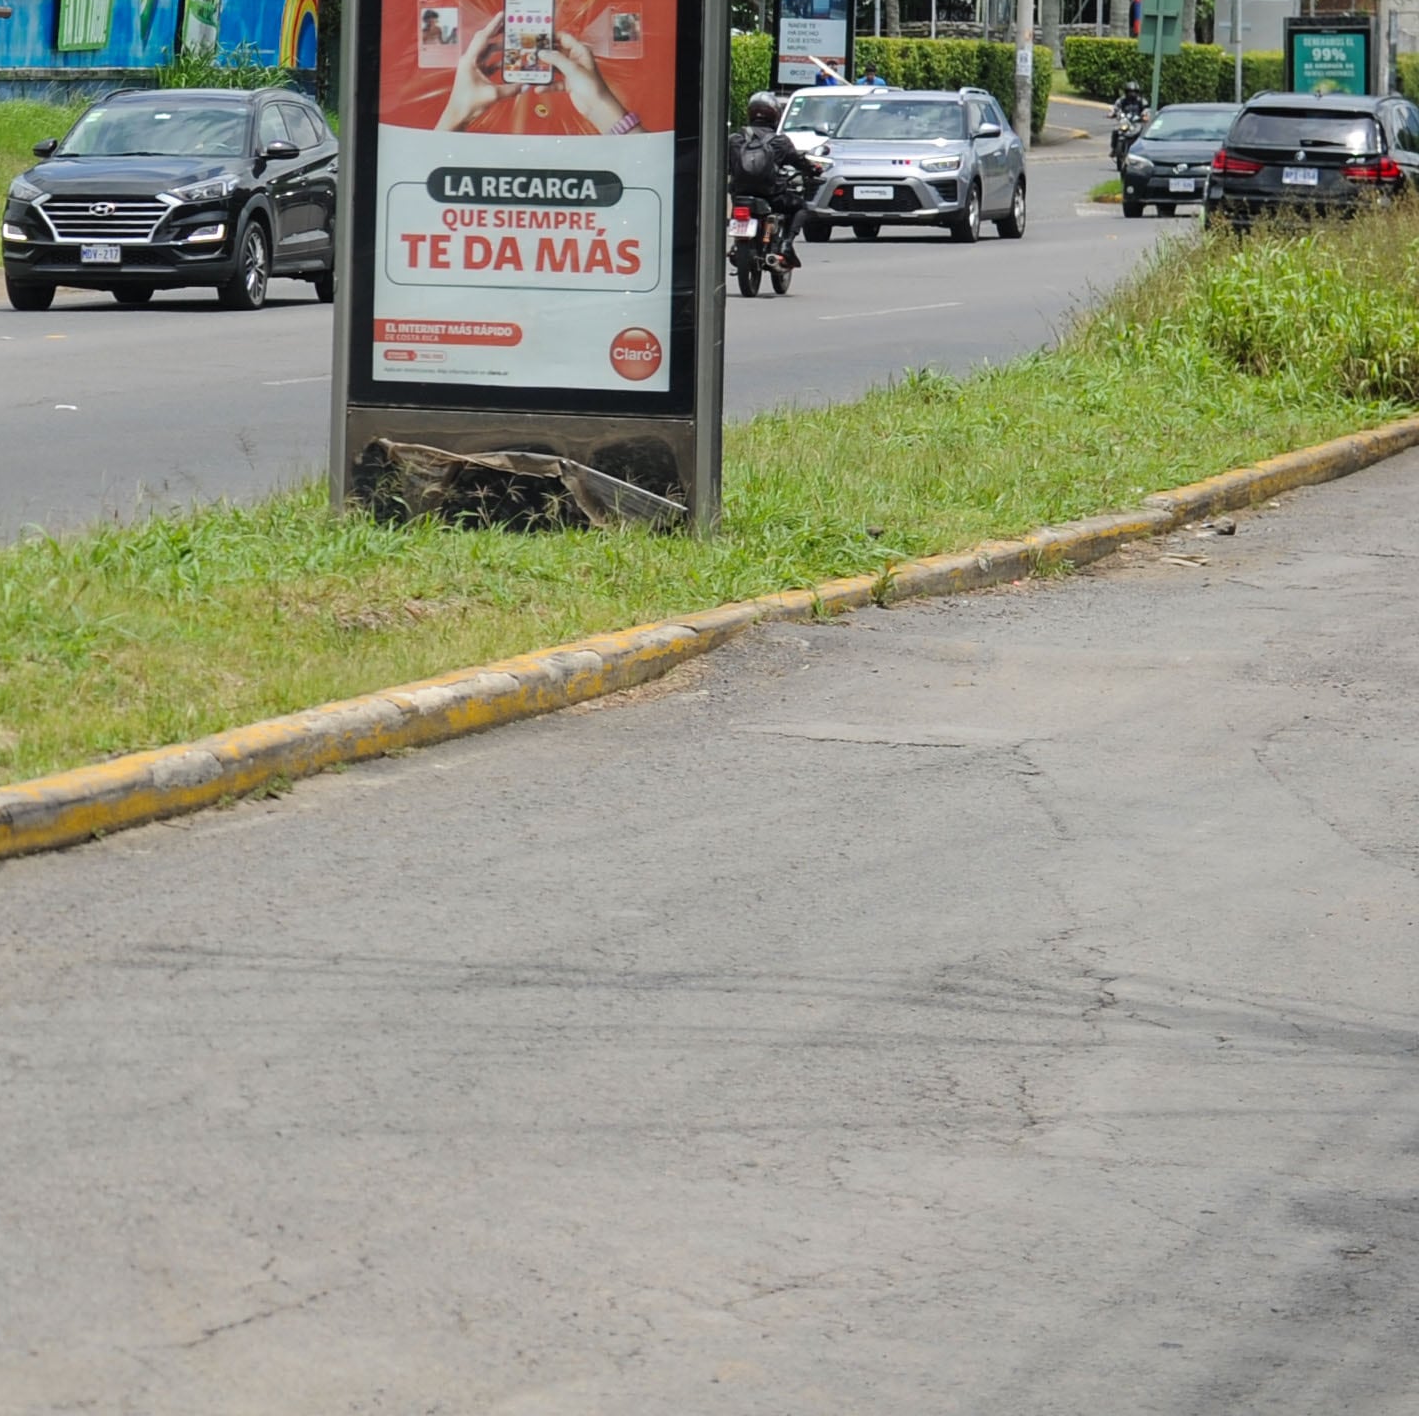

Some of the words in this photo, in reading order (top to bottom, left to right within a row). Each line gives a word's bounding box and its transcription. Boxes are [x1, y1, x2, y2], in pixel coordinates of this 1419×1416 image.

[1312, 47, 1347, 62] 99%
[444, 175, 475, 197] LA
[482, 177, 598, 200] RECARGA
[442, 208, 488, 231] QUE
[493, 209, 597, 230] SIEMPRE
[401, 233, 451, 269] TE
[464, 235, 523, 271] DA
[535, 228, 641, 275] MÁS
[385, 322, 397, 333] EL
[398, 323, 446, 334] INTERNET
[448, 322, 472, 336] MÁS
[474, 324, 513, 337] RÁPIDO
[612, 346, 654, 361] Claro
